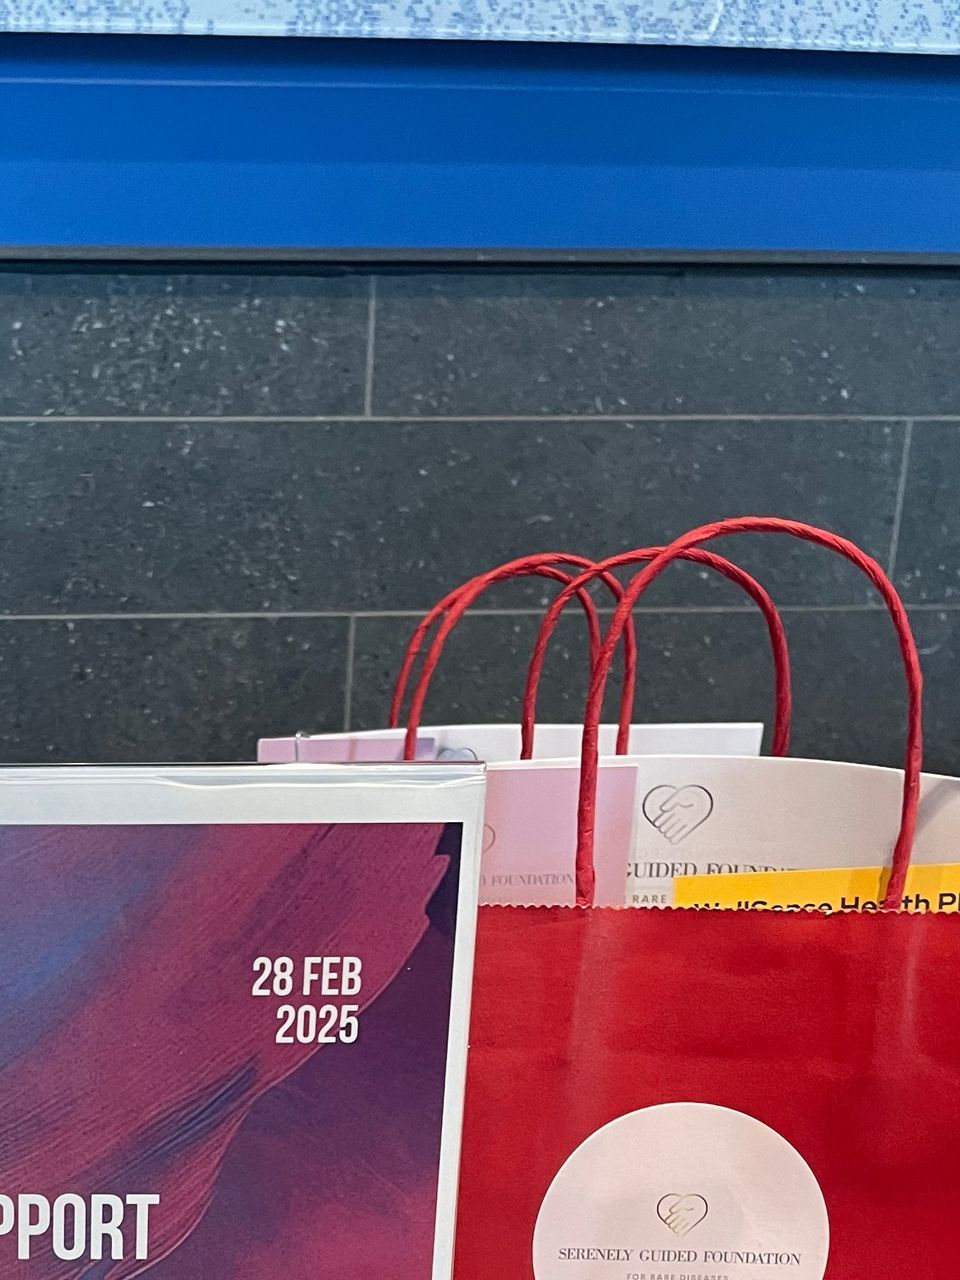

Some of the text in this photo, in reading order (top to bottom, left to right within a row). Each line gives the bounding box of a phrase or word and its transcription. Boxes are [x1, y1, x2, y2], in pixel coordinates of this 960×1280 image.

[632, 894, 667, 904] RARE
[252, 956, 362, 996] 28 FEB
[275, 1004, 359, 1044] 2025
[557, 1247, 802, 1266] SERENELY GUIDED FOUNDATION
[626, 1273, 646, 1280] FOR
